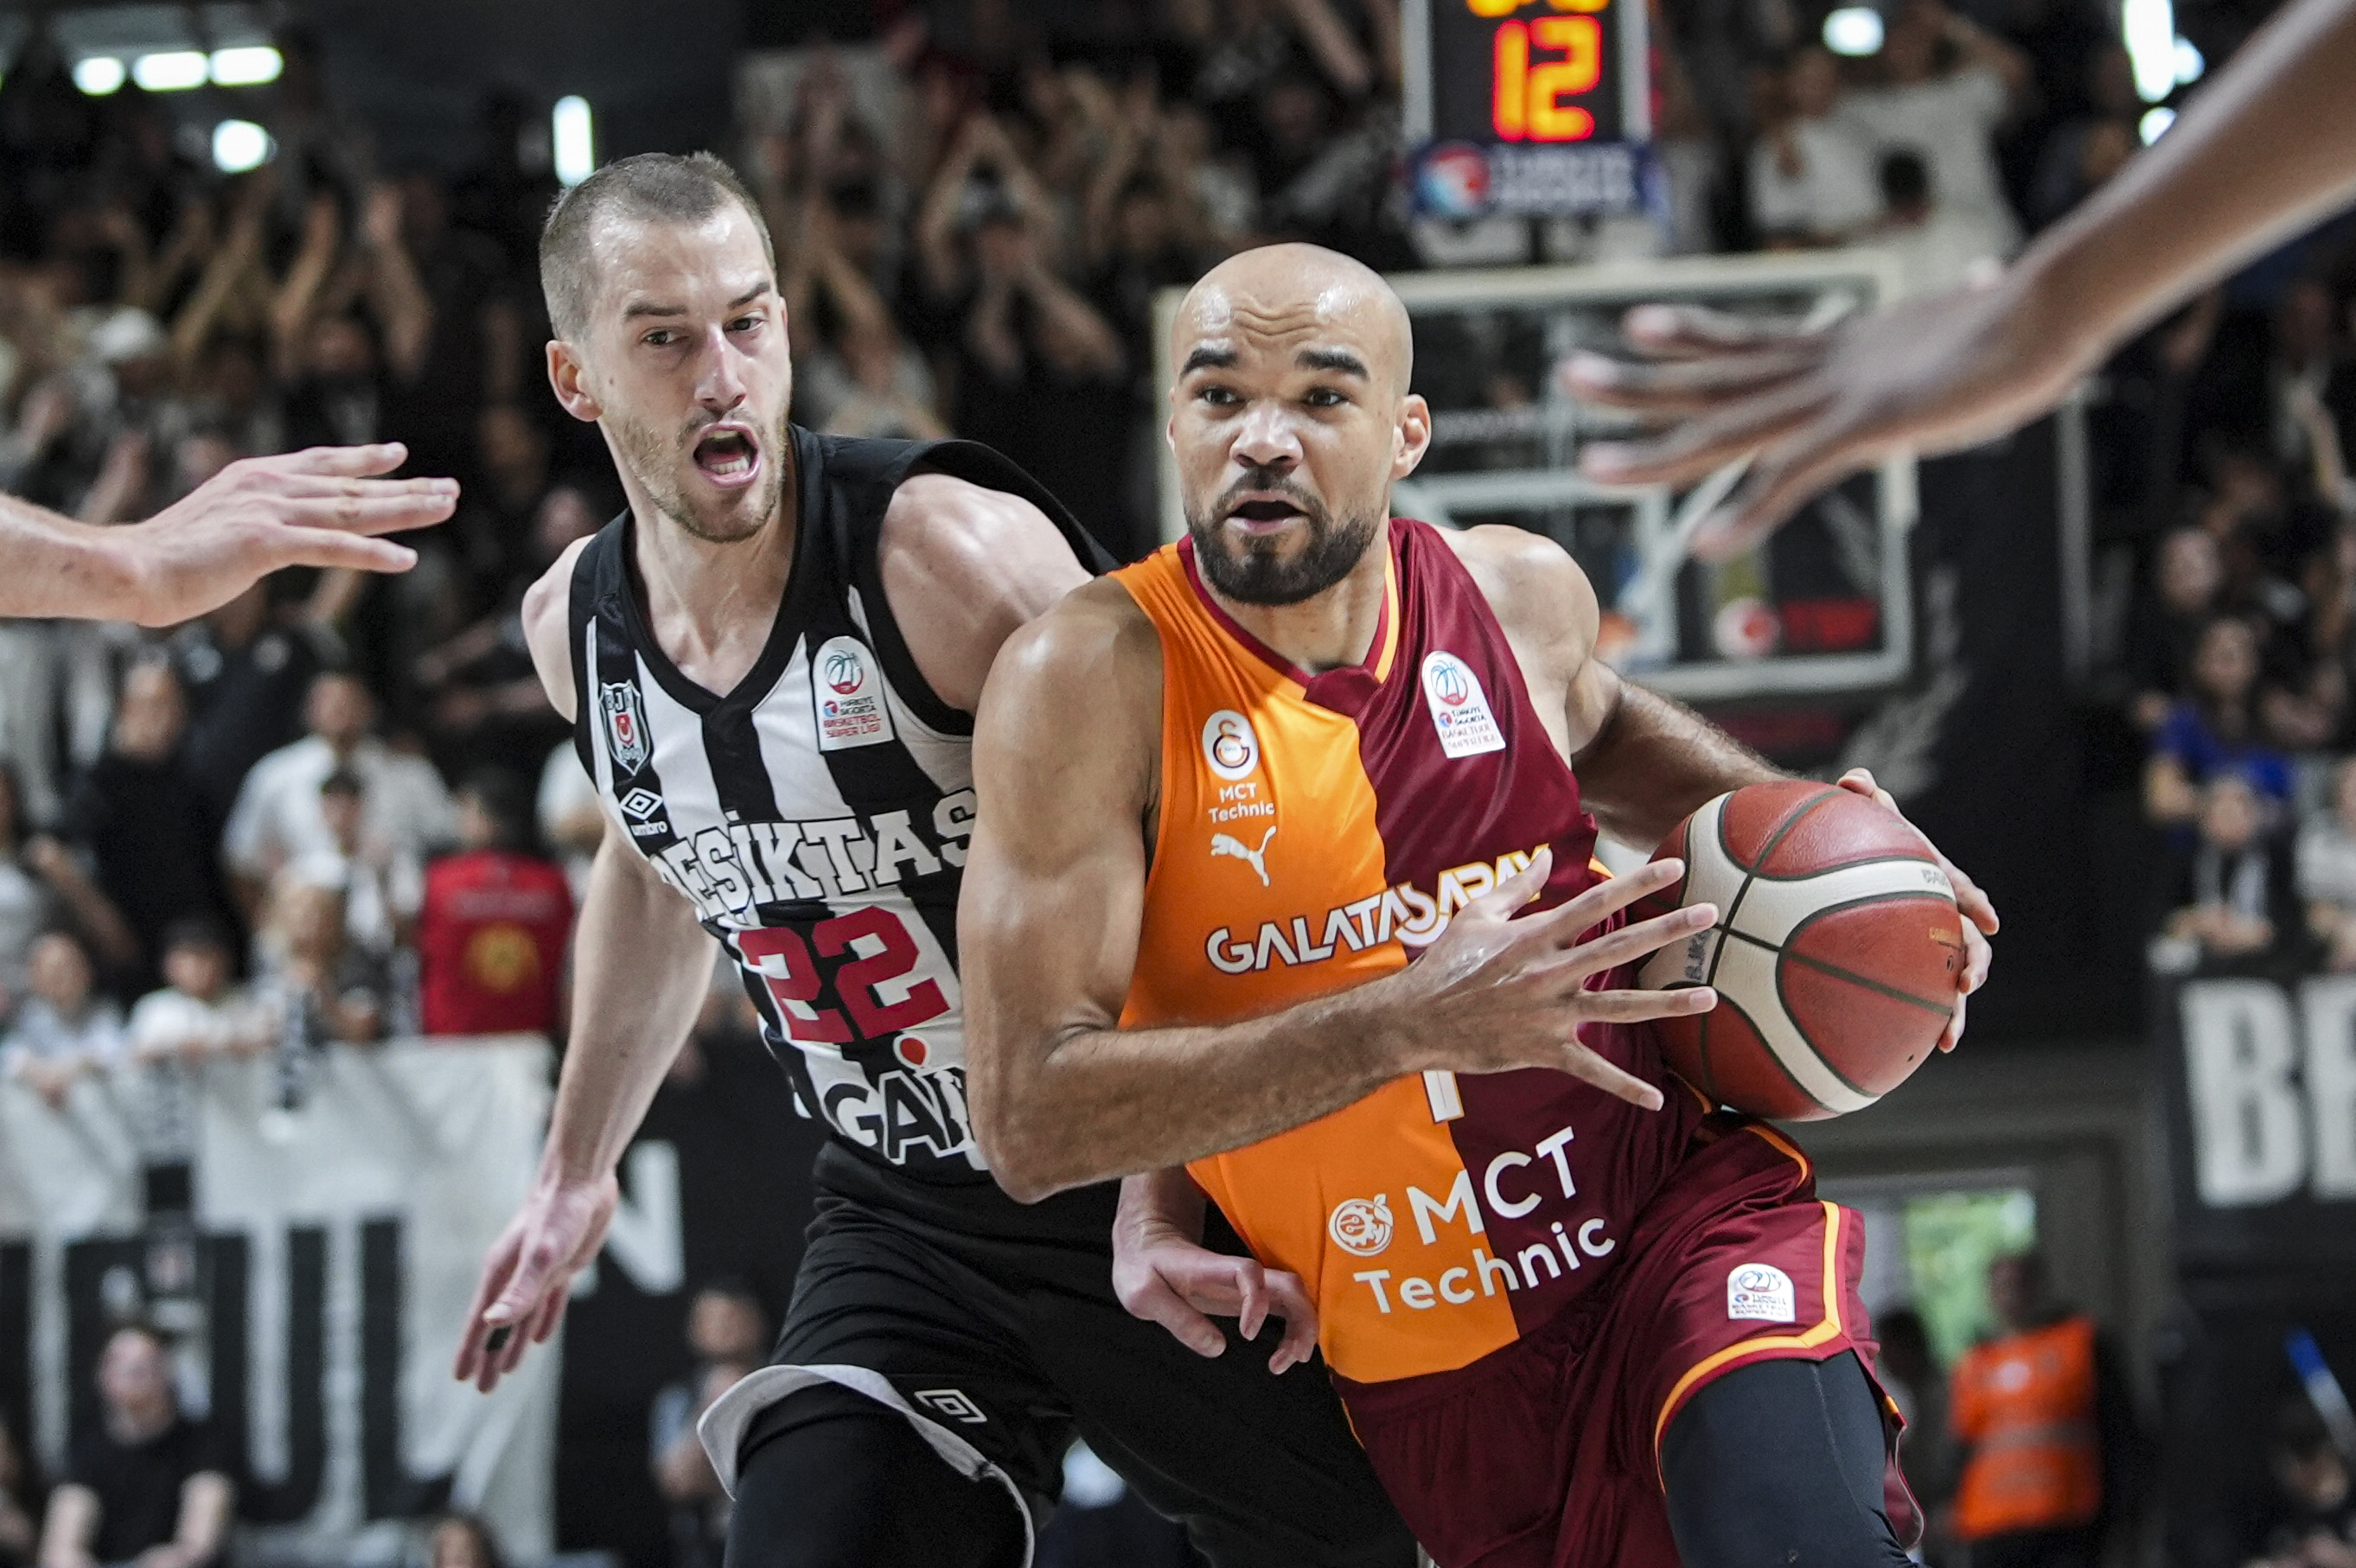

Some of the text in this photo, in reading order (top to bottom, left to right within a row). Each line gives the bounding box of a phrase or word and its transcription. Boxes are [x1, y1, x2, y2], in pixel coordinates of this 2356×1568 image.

[1493, 15, 1602, 143] 12
[1209, 800, 1275, 823] Technic
[1219, 782, 1257, 803] MCT
[738, 905, 950, 1042] 22
[1406, 1125, 1576, 1246] MCT
[1353, 1218, 1615, 1314] Technic
